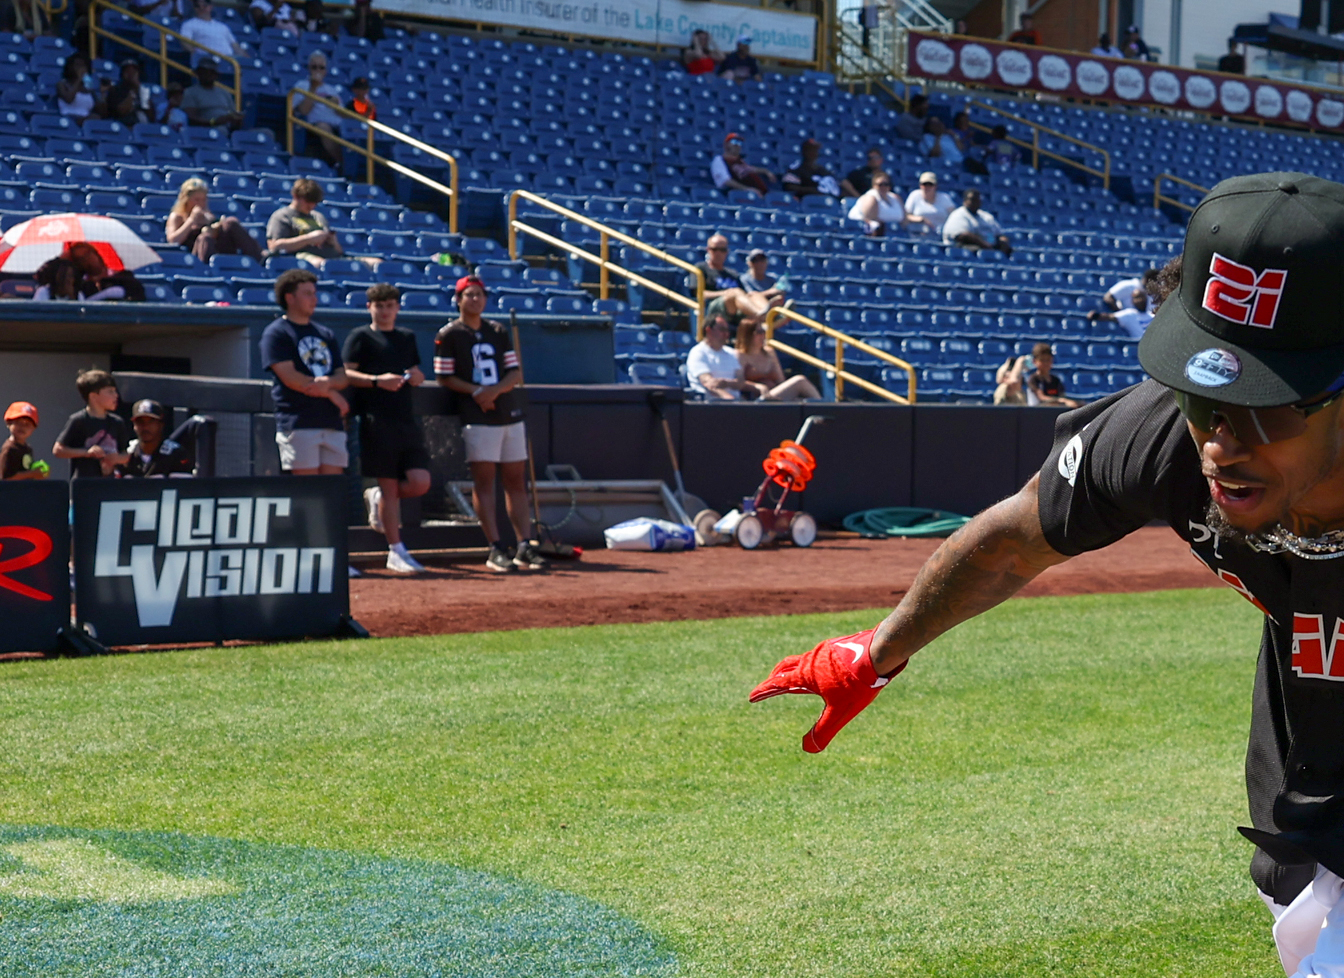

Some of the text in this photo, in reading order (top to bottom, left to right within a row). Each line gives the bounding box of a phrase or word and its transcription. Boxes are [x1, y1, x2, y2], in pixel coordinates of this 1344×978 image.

[581, 5, 598, 23] of
[603, 8, 630, 27] the
[635, 9, 674, 33] Lake
[1202, 252, 1288, 329] 21
[95, 489, 291, 577] Clear
[131, 545, 335, 627] Vision
